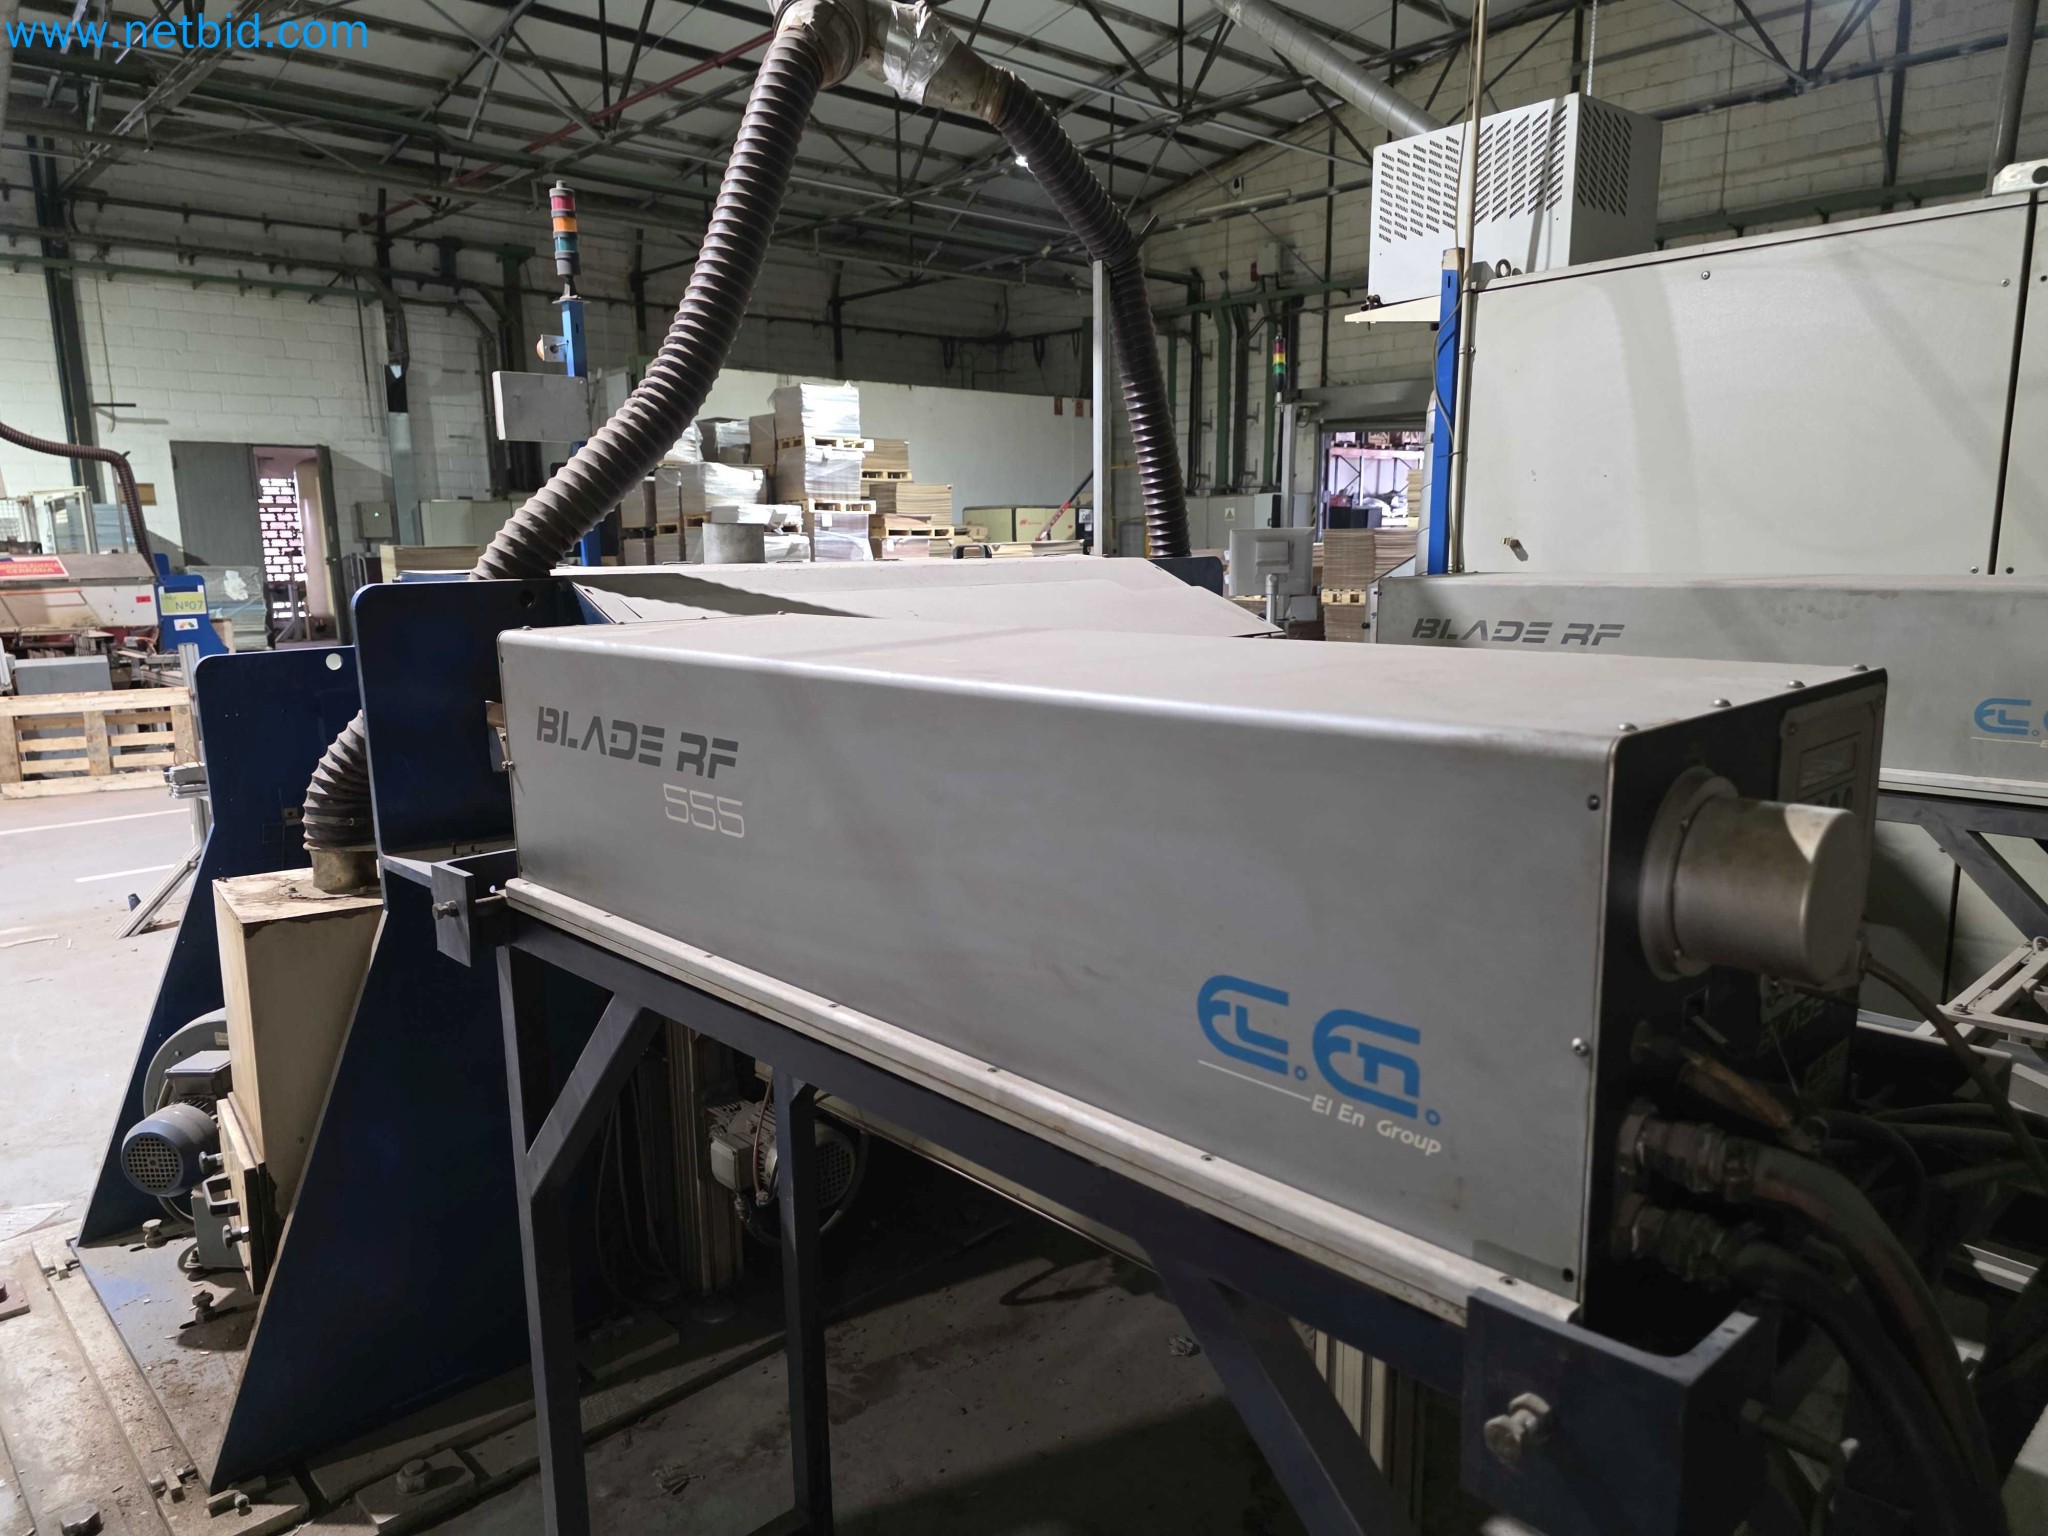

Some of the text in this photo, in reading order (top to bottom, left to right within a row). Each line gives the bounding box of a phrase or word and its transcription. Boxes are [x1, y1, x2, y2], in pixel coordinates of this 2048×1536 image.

[1412, 618, 1625, 646] BLADE RF
[536, 706, 739, 779] BLADE RF
[1311, 1095, 1442, 1156] El En Group
